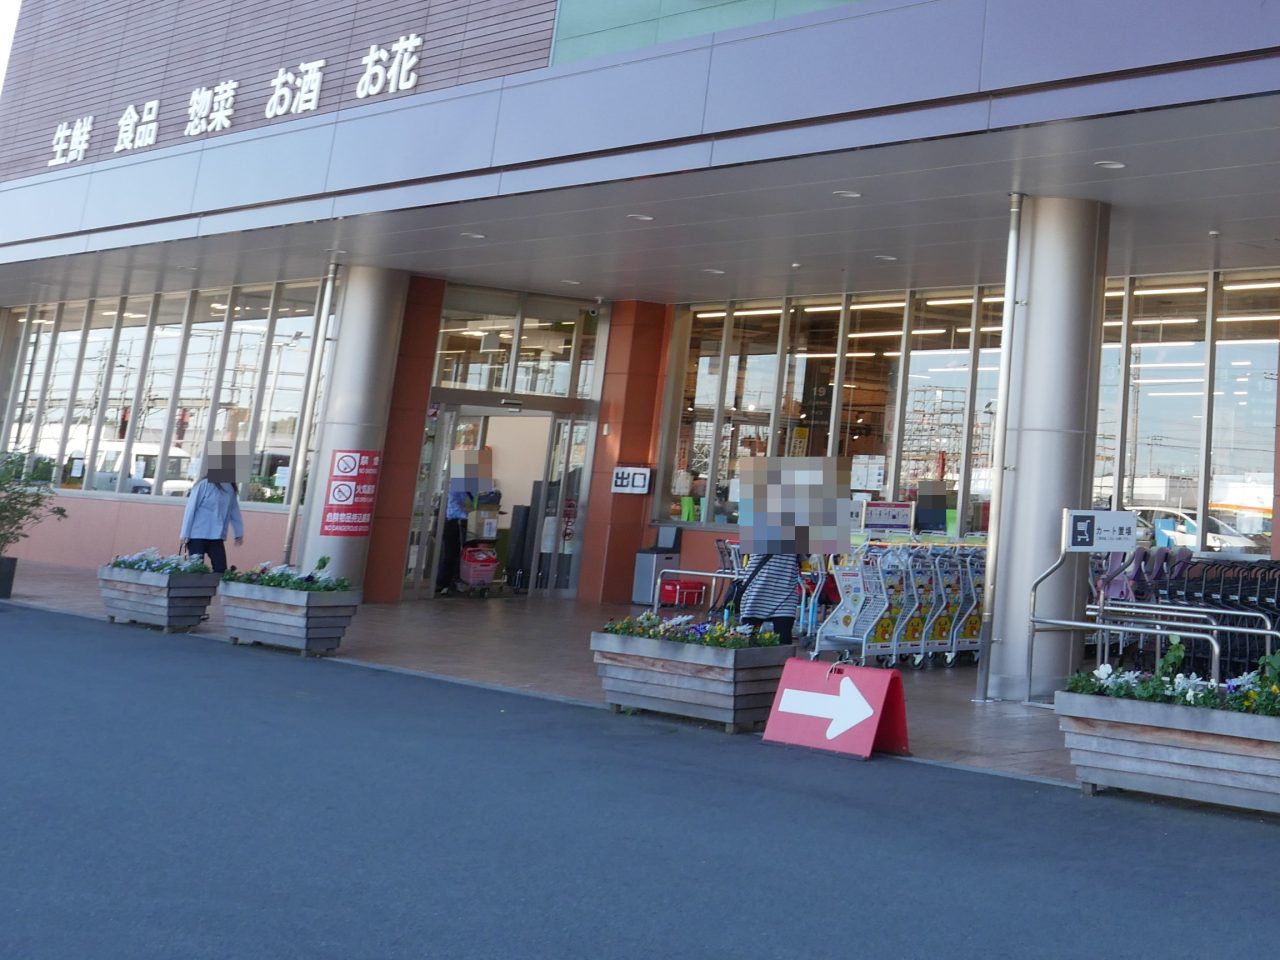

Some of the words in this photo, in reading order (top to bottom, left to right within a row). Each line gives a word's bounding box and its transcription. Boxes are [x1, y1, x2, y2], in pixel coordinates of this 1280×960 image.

[47, 115, 94, 167] 生鮮
[113, 99, 160, 153] 食品
[183, 79, 239, 137] 惣菜
[265, 58, 326, 120] お酒
[355, 32, 422, 100] お花
[614, 471, 647, 489] 出口
[1095, 526, 1132, 537] カート置場
